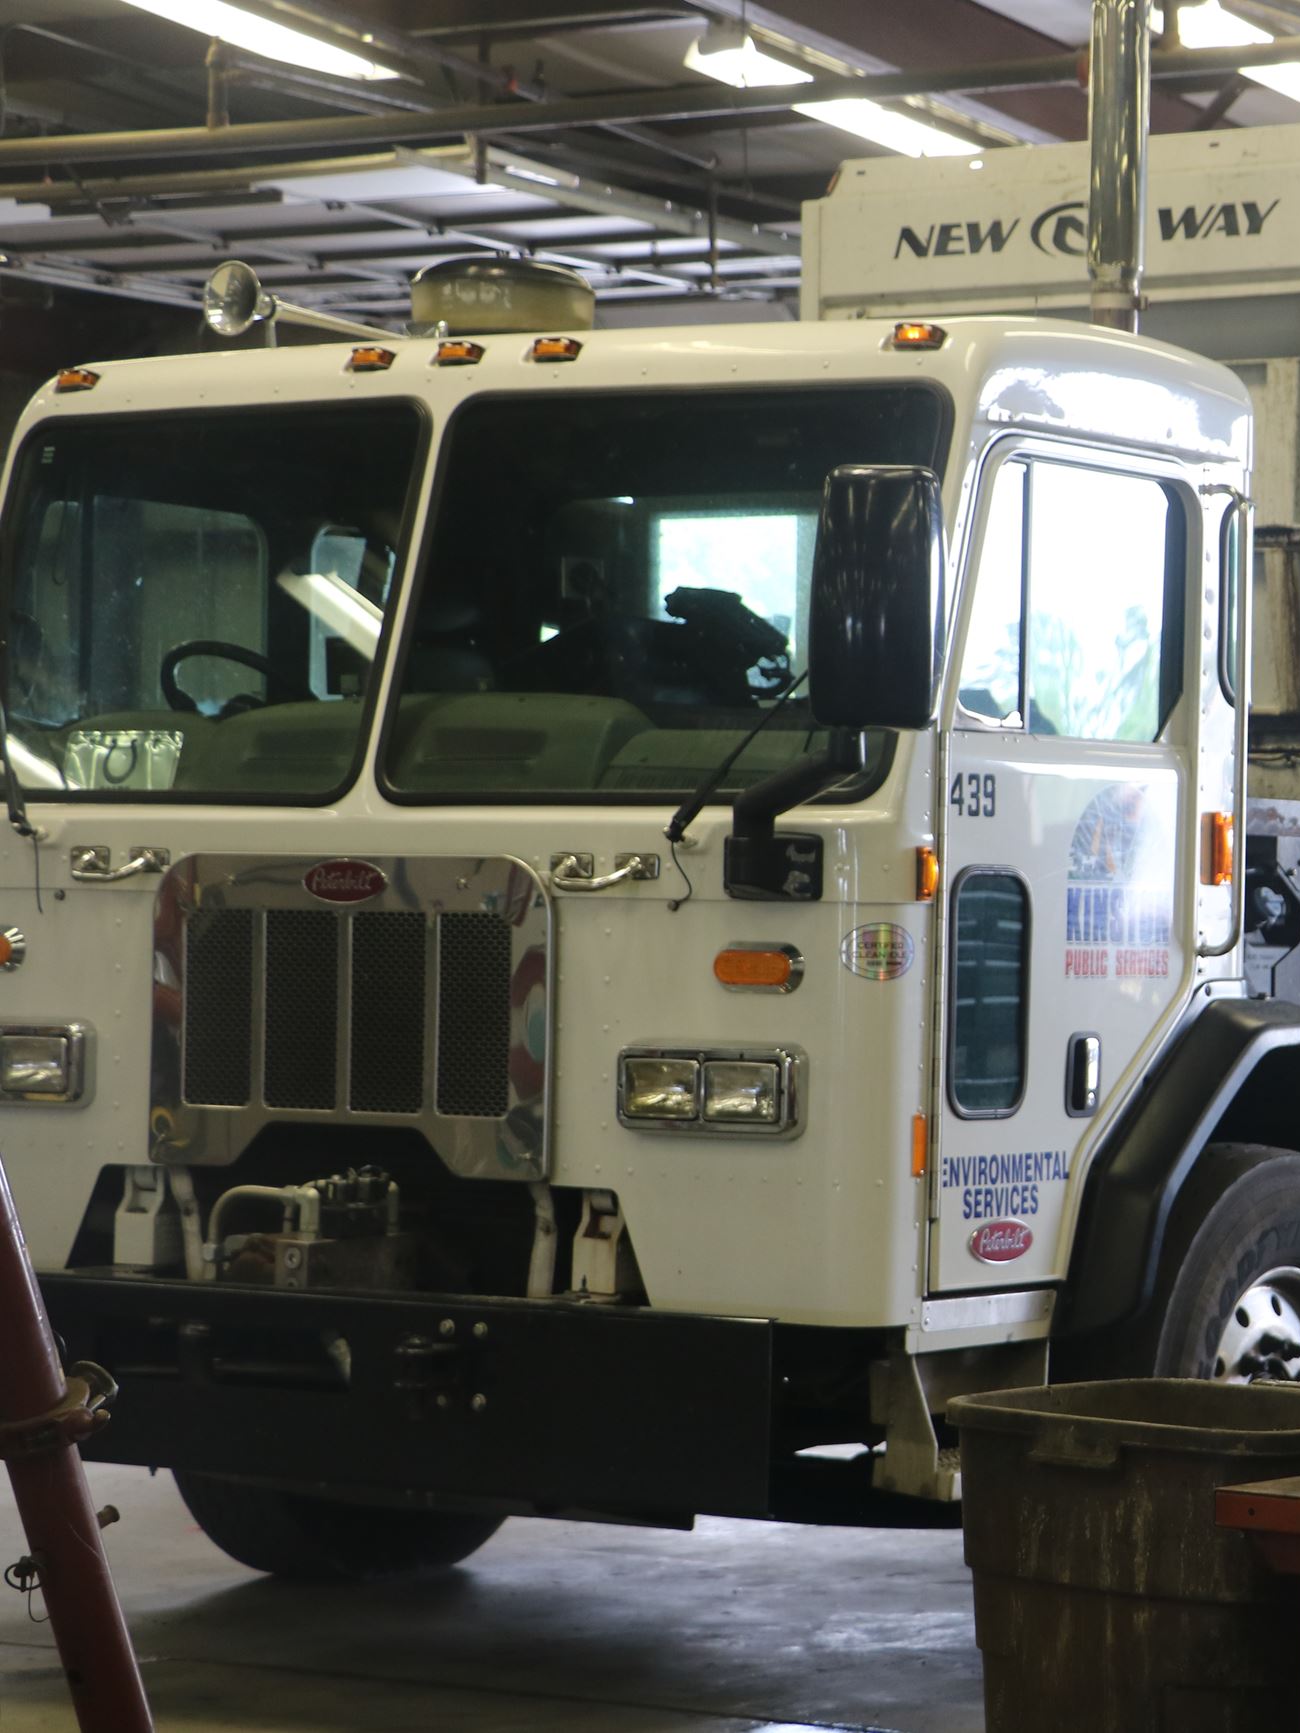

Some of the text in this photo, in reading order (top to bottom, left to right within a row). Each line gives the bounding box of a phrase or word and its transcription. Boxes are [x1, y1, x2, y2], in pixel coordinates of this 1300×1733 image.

[894, 199, 1281, 260] NEW WAY
[950, 772, 996, 817] 439
[1065, 949, 1169, 978] PUBLIC SERVICES
[962, 1184, 1039, 1219] SERVICES
[979, 1228, 1031, 1254] Peterbilt
